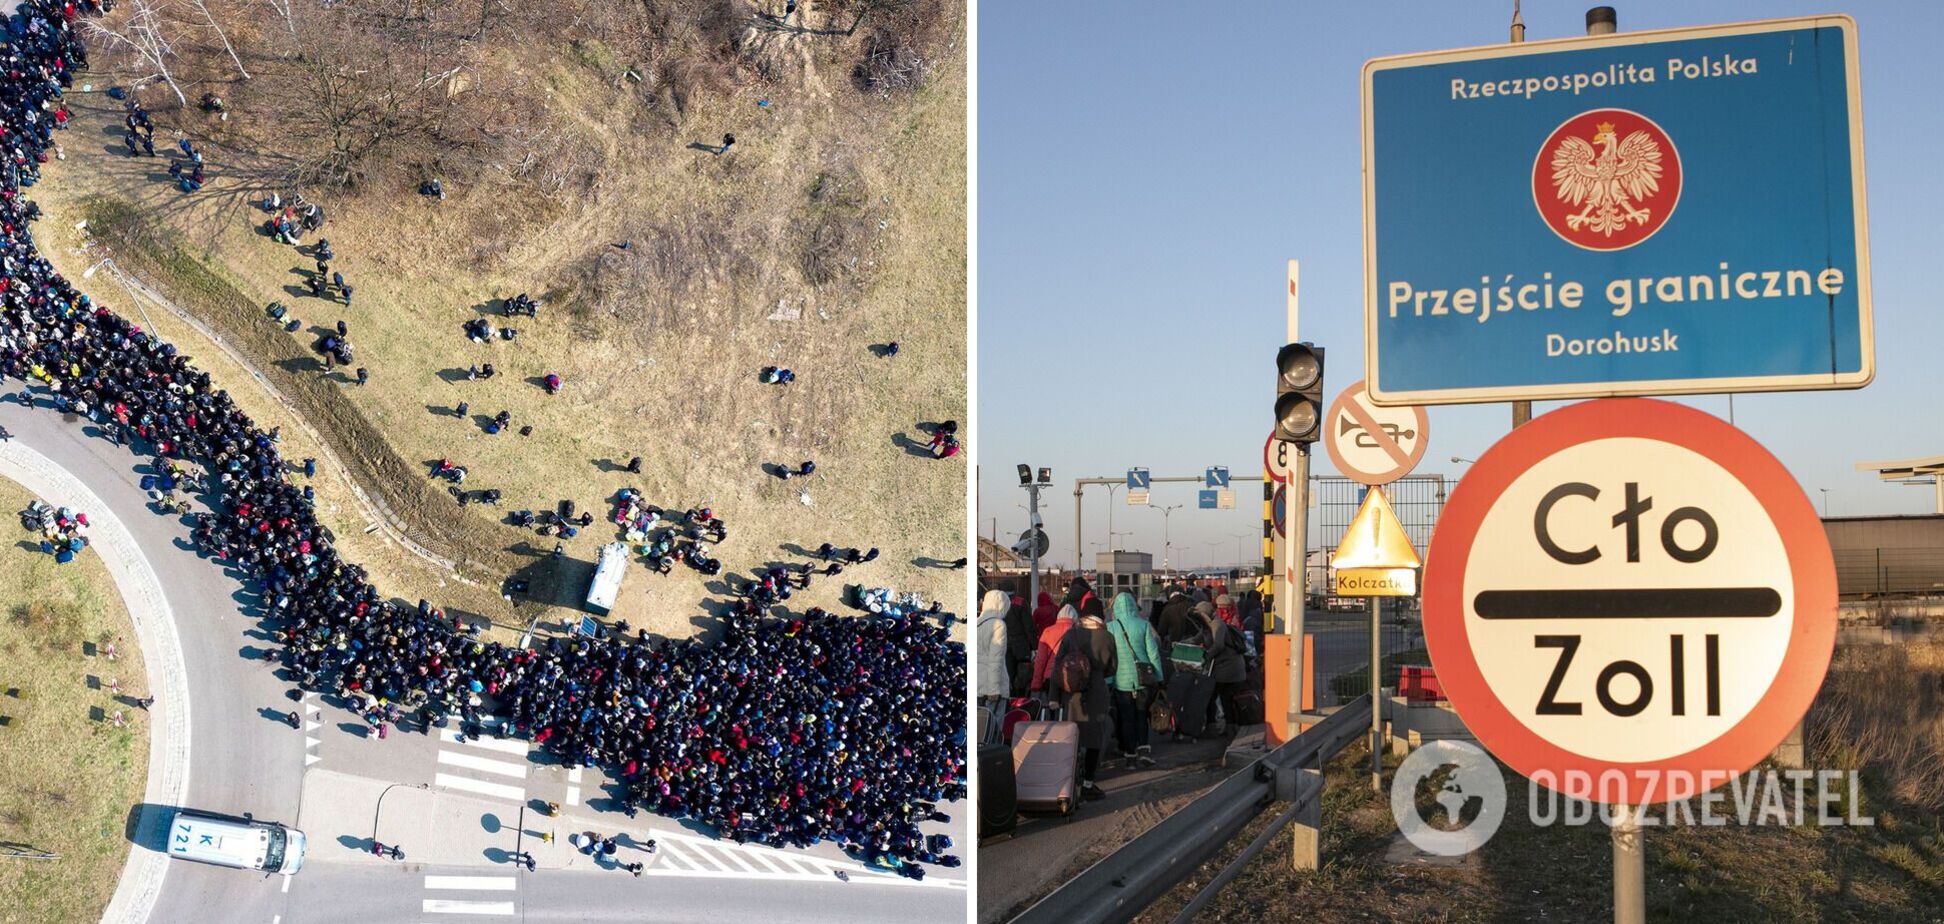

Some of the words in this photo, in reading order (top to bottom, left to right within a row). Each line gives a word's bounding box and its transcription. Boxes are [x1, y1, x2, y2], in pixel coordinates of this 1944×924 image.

[1451, 63, 1654, 99] Rzeczpospolita
[1669, 53, 1757, 79] Polska
[1389, 272, 1583, 322] Przejście
[1606, 263, 1844, 316] graniczne
[1547, 329, 1678, 356] Dorohusk
[1535, 483, 1718, 564] Cło
[1339, 576, 1411, 589] Kolczatk
[1535, 635, 1720, 716] Zoll
[175, 824, 192, 853] 721
[199, 834, 213, 846] K
